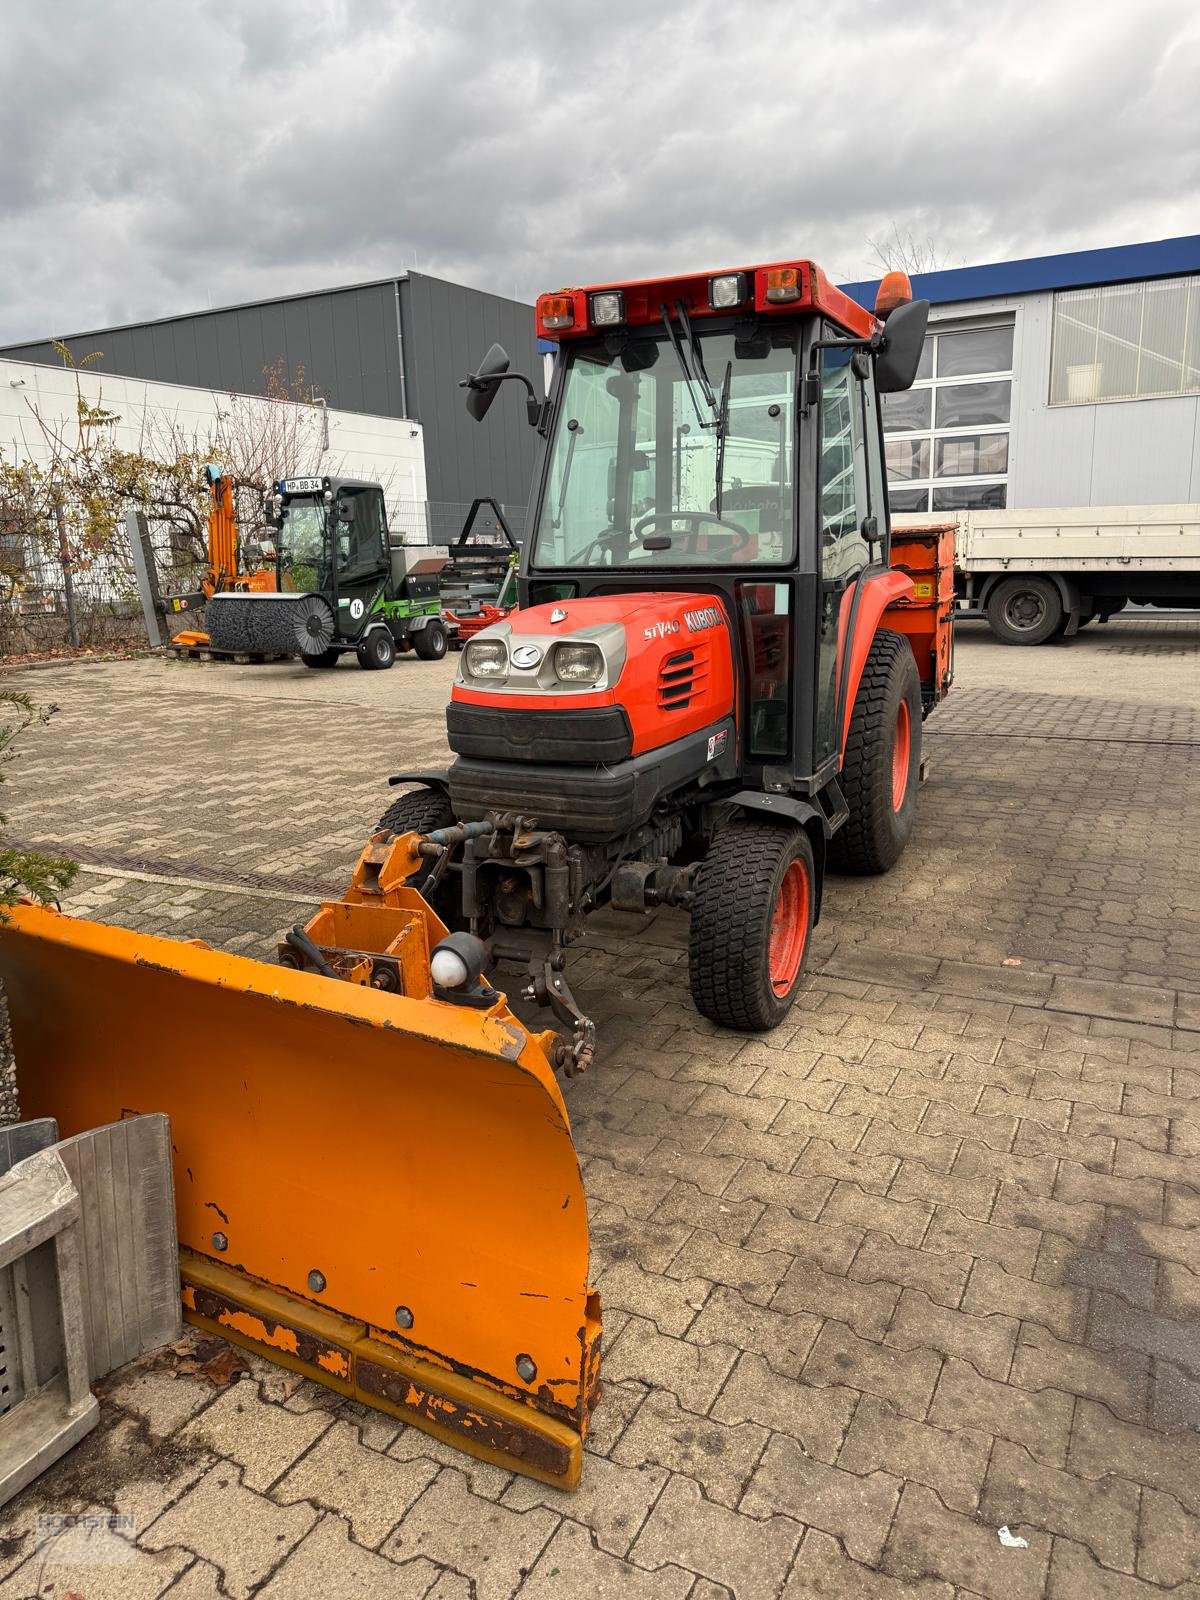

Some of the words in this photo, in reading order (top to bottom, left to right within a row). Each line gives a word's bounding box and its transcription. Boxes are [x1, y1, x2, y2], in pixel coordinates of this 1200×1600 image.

[287, 481, 296, 491] HP
[299, 480, 309, 490] BB
[310, 480, 319, 490] 34
[353, 603, 361, 615] 16
[683, 606, 724, 633] KUBOTA
